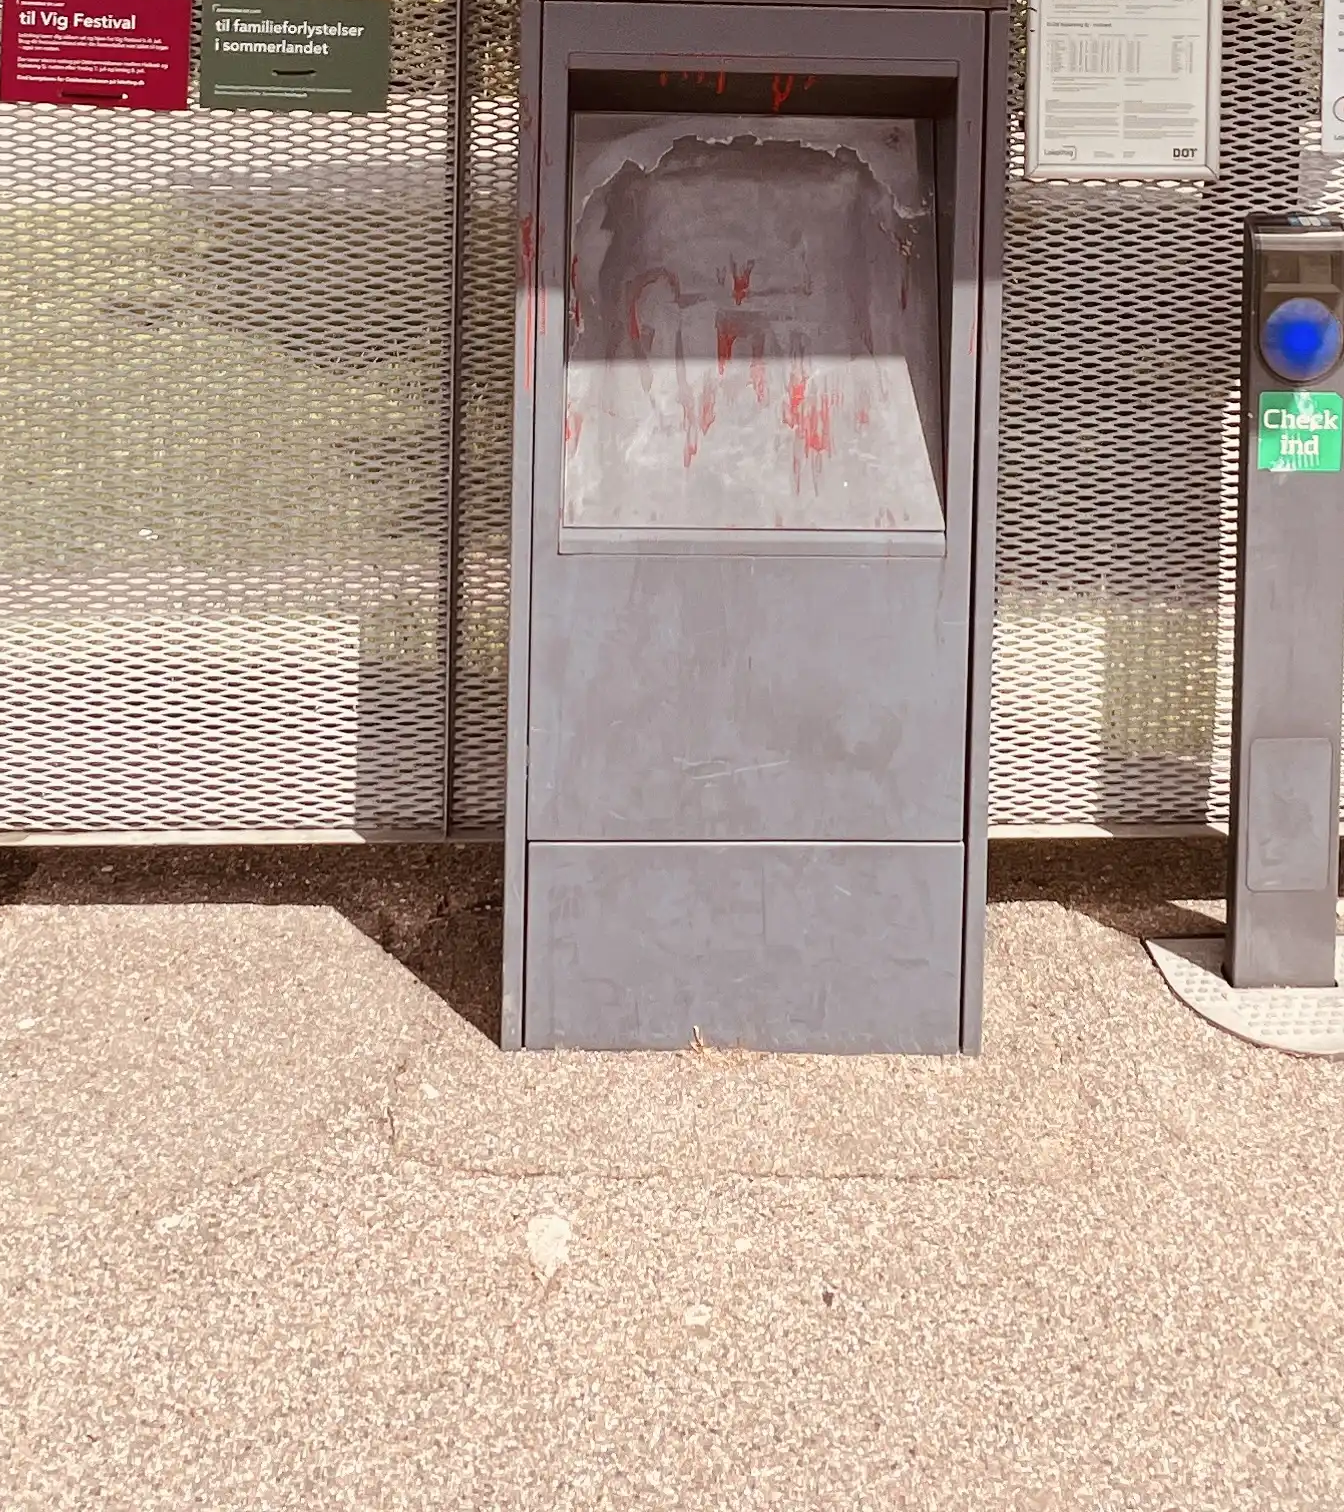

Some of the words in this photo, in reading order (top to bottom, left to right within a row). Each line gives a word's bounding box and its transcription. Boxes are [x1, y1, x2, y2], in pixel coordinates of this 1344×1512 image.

[19, 10, 36, 26] til
[40, 11, 69, 31] Vig
[73, 13, 136, 30] Festival
[215, 19, 231, 33] til
[233, 19, 365, 39] familieforlystelser
[214, 38, 220, 51] i
[223, 39, 330, 55] sommerlandet
[1172, 147, 1197, 159] DOT
[1263, 408, 1339, 431] Check
[1280, 434, 1320, 456] ind
